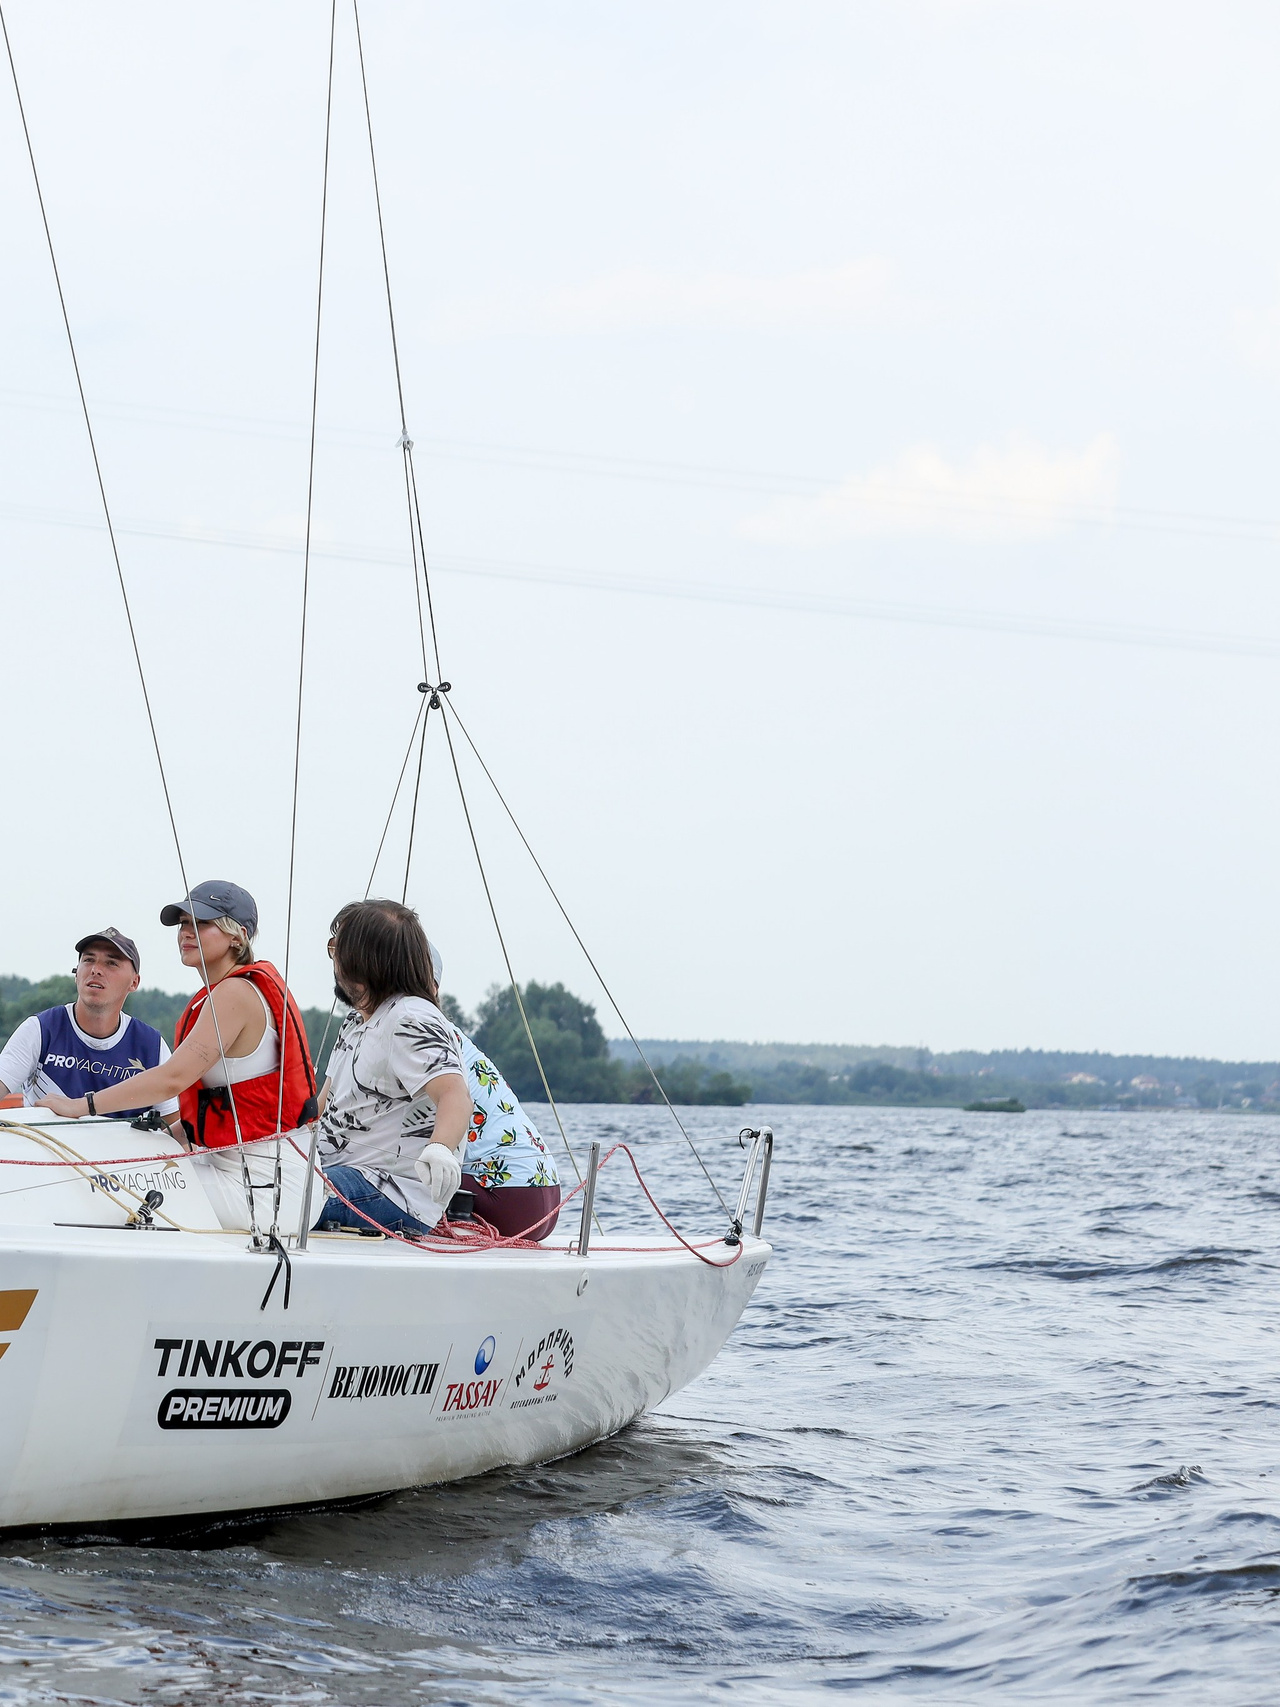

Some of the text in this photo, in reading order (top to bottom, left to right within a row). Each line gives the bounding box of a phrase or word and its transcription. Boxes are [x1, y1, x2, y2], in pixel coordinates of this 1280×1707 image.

[44, 1053, 141, 1080] PROYACHTIN
[89, 1171, 186, 1193] PROYACHTING
[153, 1338, 325, 1378] TINKOFF
[327, 1362, 440, 1401] ВЕДОМОСТИ
[442, 1379, 504, 1411] TASSAY
[164, 1396, 286, 1422] PREMIUM
